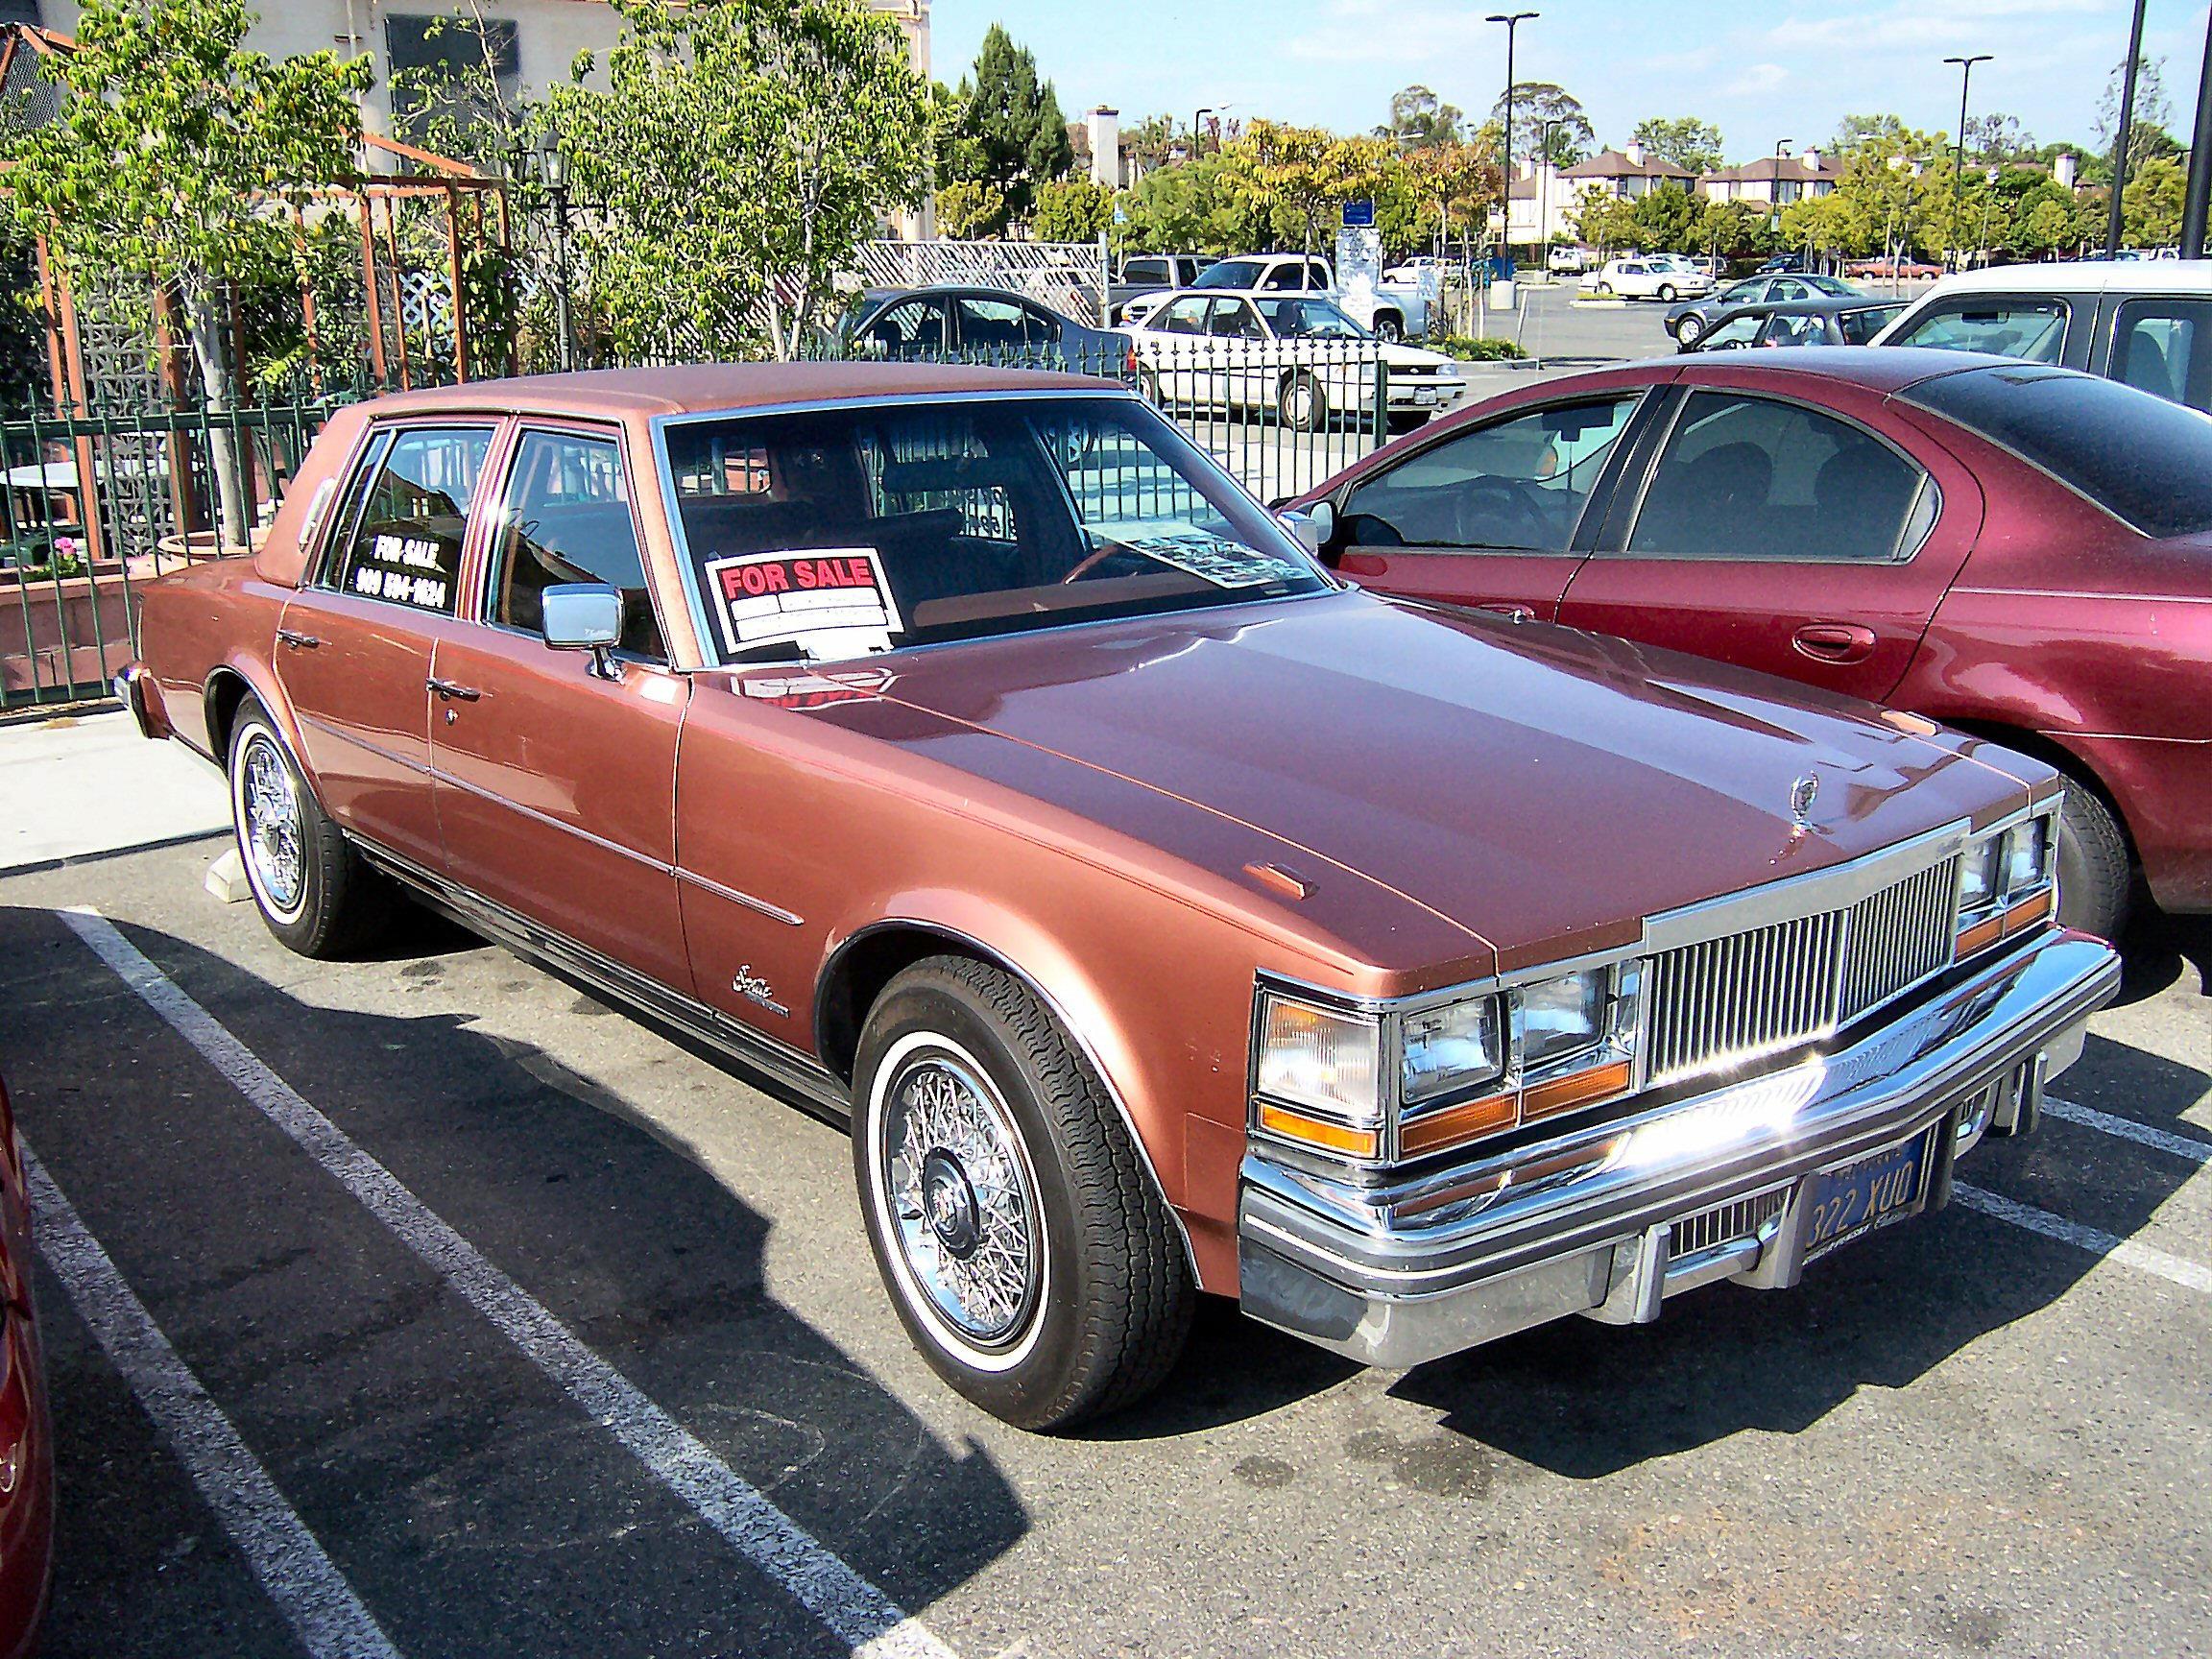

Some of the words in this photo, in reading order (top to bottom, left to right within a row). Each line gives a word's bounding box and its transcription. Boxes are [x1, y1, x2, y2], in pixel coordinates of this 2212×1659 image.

[374, 534, 402, 563] FOR
[402, 539, 440, 569] SALE
[722, 563, 789, 599] FOR
[792, 558, 874, 589] SALE
[1805, 1188, 1857, 1249] 322
